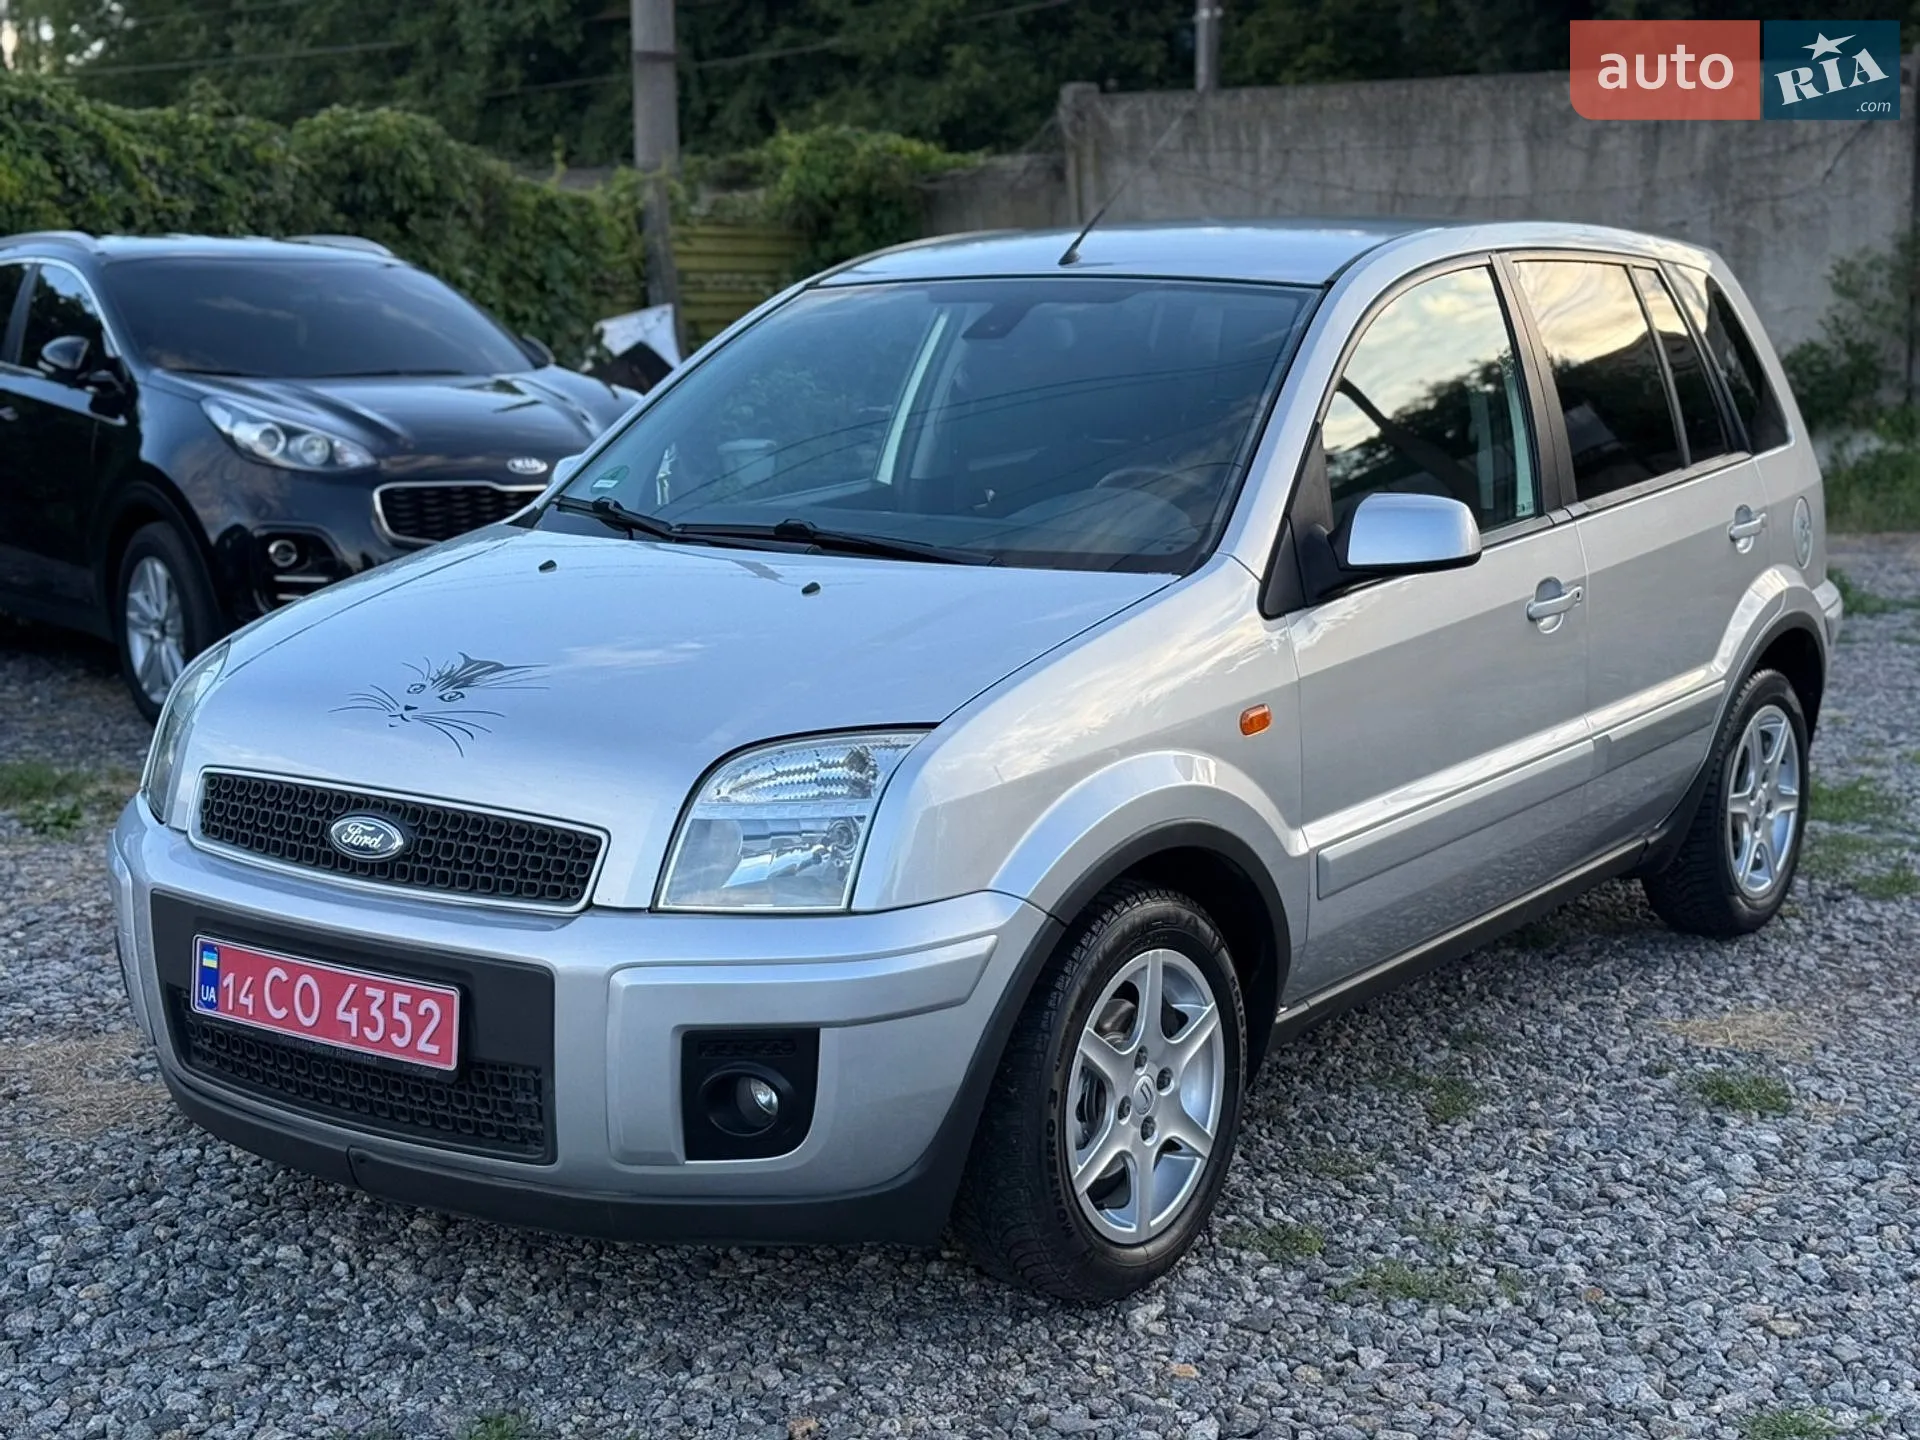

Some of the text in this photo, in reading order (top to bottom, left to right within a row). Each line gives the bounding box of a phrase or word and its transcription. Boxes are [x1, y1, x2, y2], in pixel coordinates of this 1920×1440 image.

[341, 822, 385, 849] Ford
[201, 984, 216, 1003] UA
[222, 972, 255, 1015] 14
[264, 966, 321, 1027] CO
[336, 983, 441, 1055] 4352
